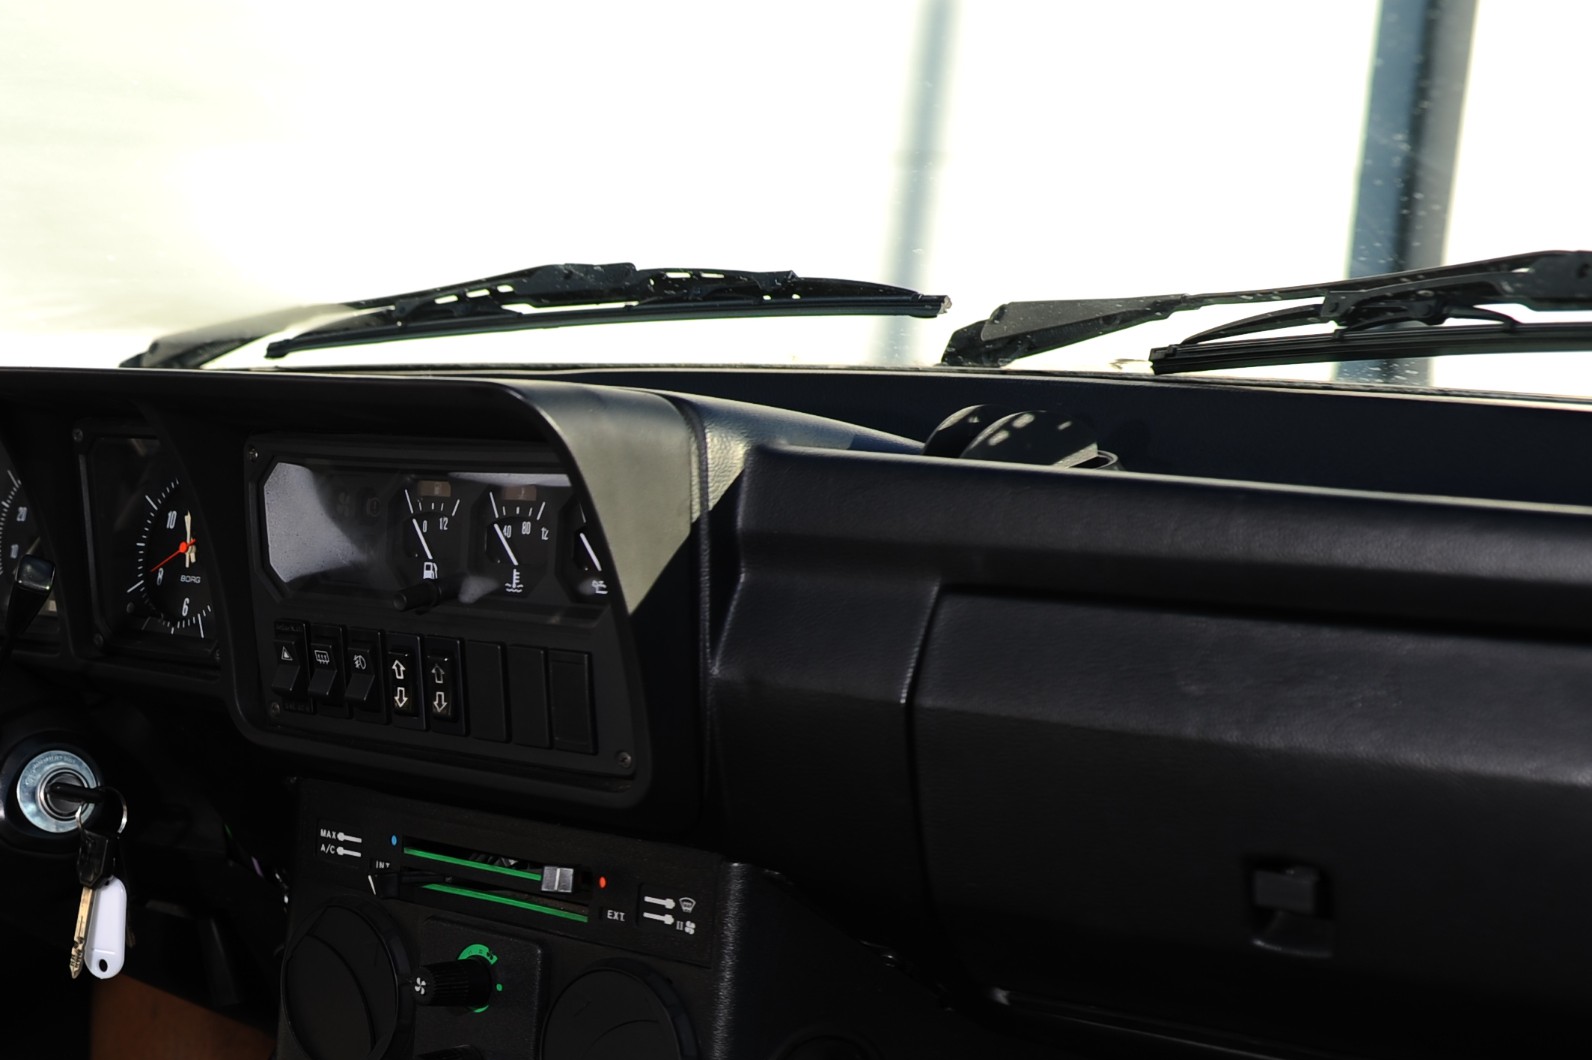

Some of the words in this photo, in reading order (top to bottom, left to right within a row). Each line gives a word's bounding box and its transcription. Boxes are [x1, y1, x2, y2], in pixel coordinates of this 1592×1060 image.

[166, 510, 178, 530] 10
[156, 567, 165, 587] 8
[180, 575, 202, 584] BORG
[182, 597, 191, 617] 6
[320, 828, 337, 840] MAX
[320, 843, 336, 855] A/C
